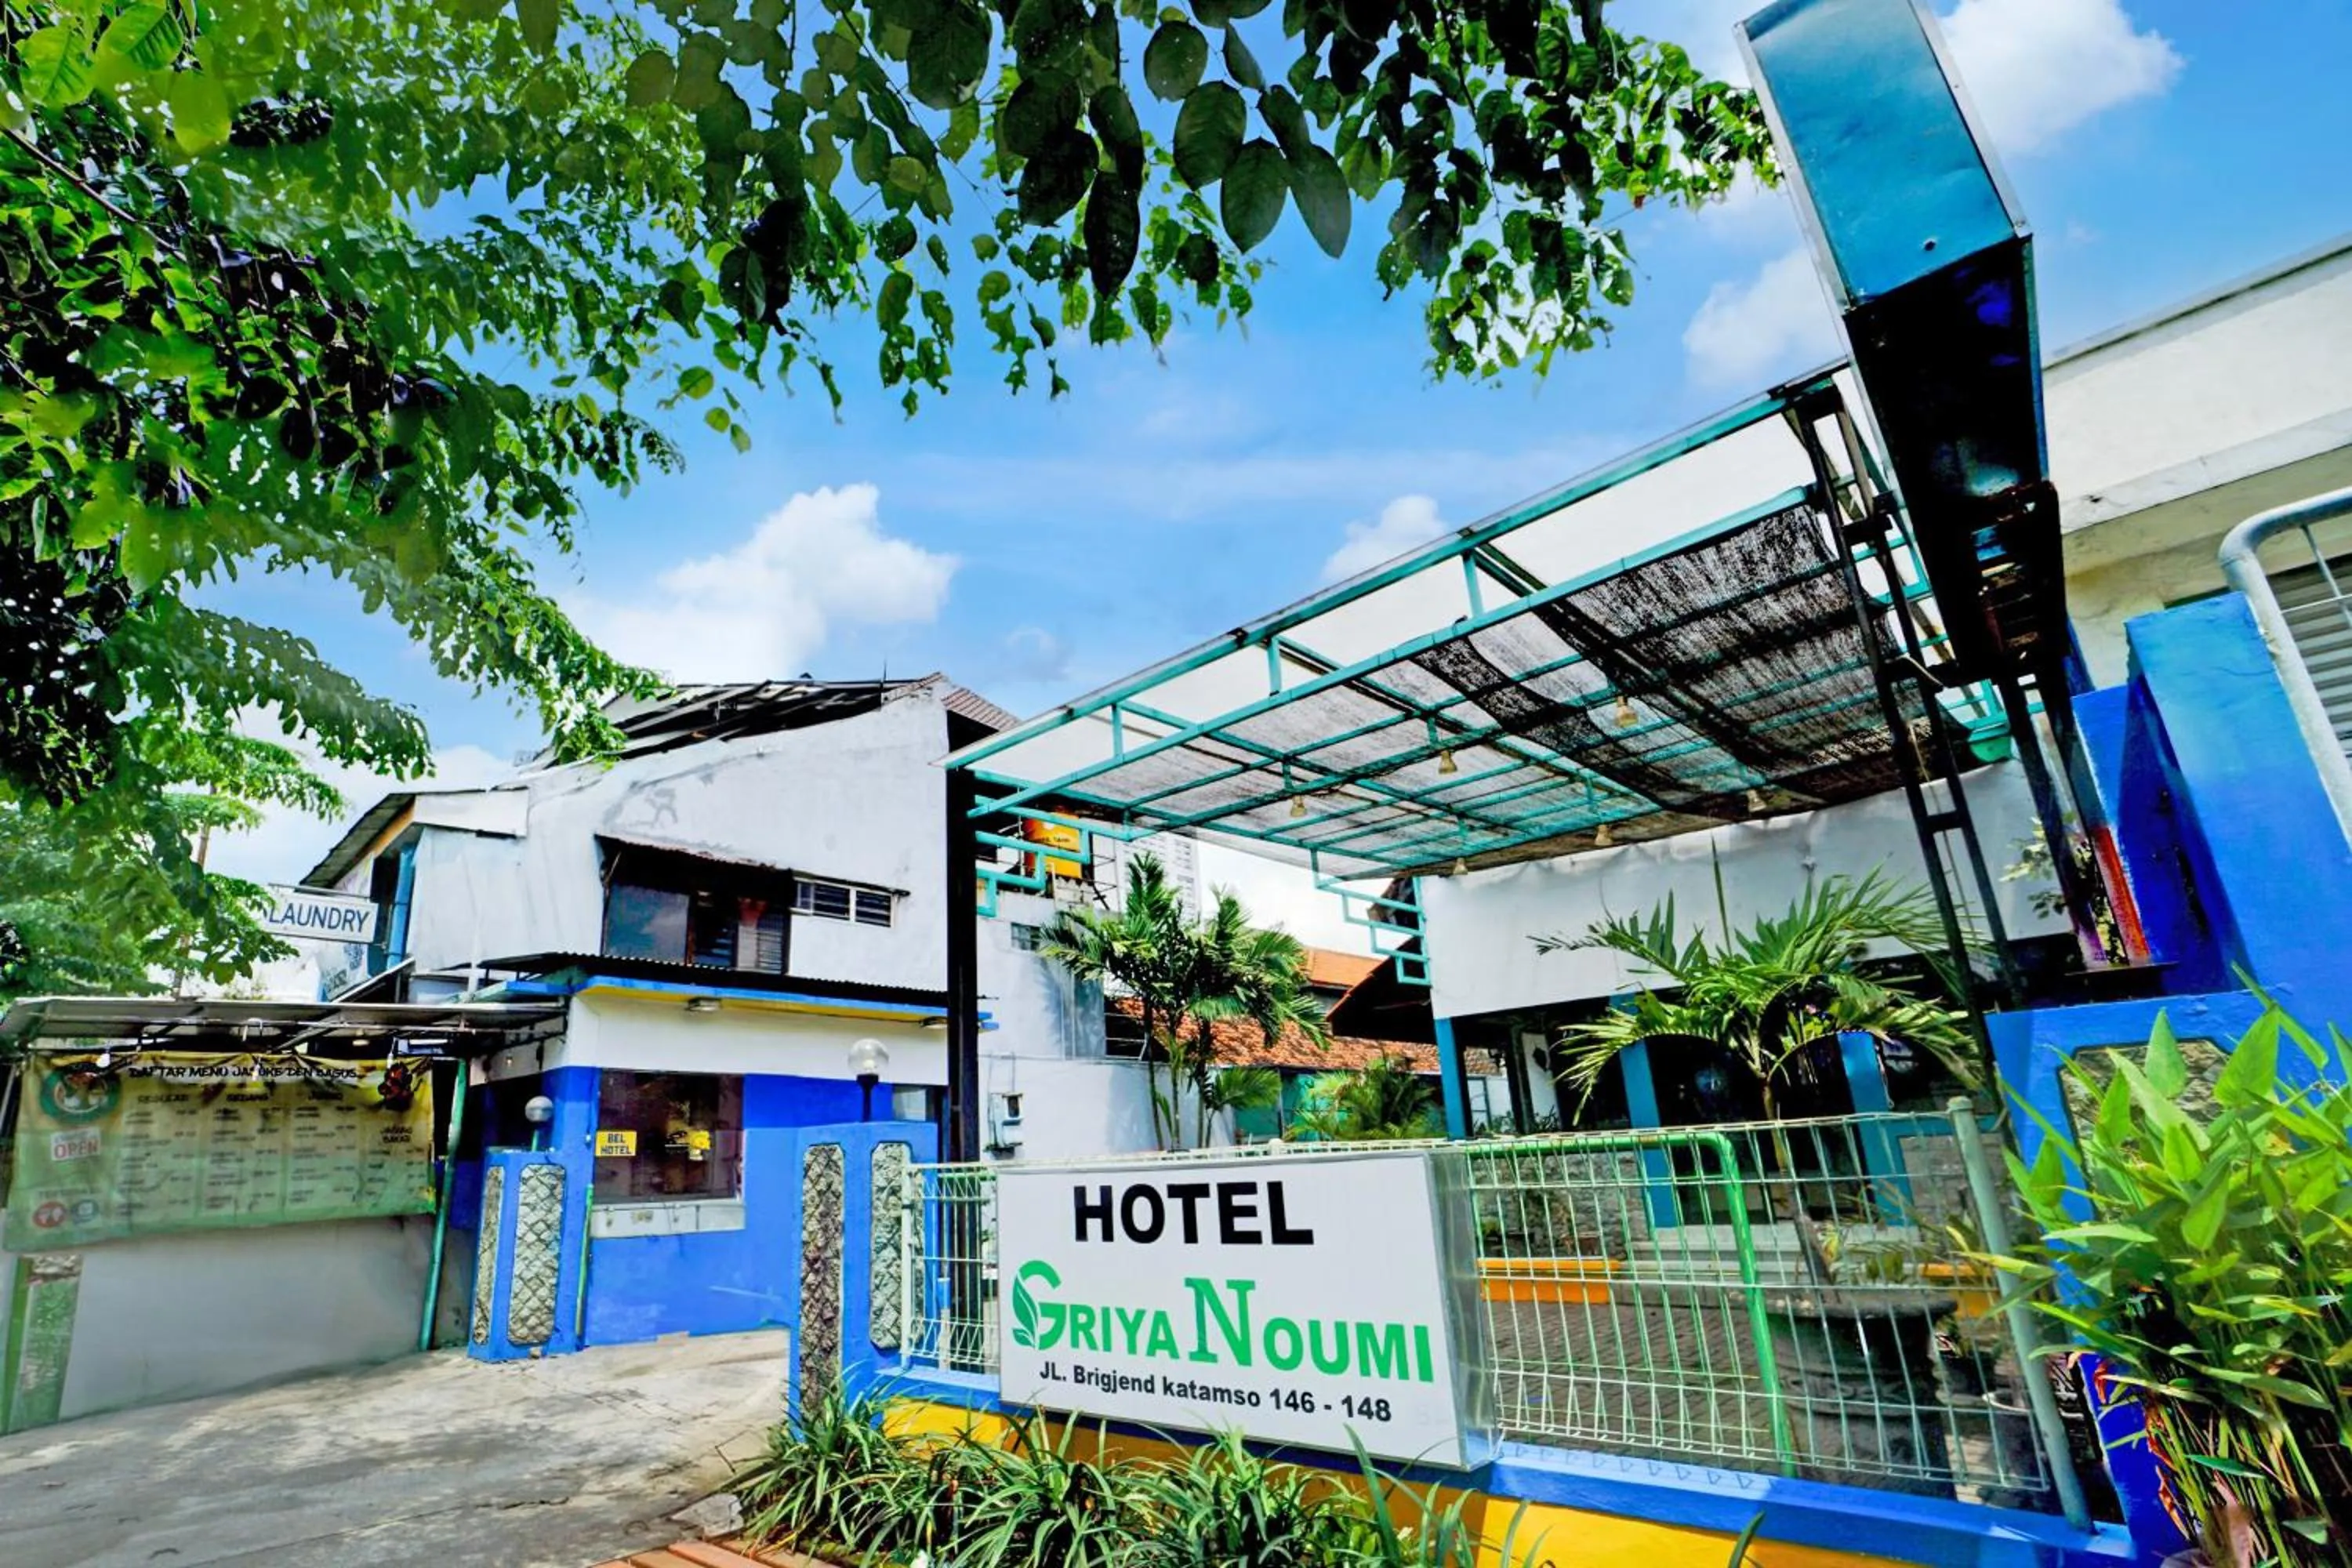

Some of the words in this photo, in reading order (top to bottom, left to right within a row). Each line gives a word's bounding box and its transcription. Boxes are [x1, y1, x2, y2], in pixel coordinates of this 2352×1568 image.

[268, 902, 371, 934] LAUNDRY
[189, 1066, 229, 1078] MENU
[53, 1138, 99, 1159] OPEN
[601, 1145, 632, 1155] HOTEL
[608, 1133, 626, 1143] BEL
[1073, 1181, 1314, 1245] HOTEL
[1011, 1259, 1180, 1362] GRIYA
[1183, 1276, 1435, 1385] NOUMI
[1039, 1361, 1067, 1382] JL.
[1073, 1365, 1156, 1394] Brigjend
[1163, 1376, 1261, 1408] katamso
[1269, 1388, 1316, 1414] 146
[1341, 1396, 1392, 1423] 148
